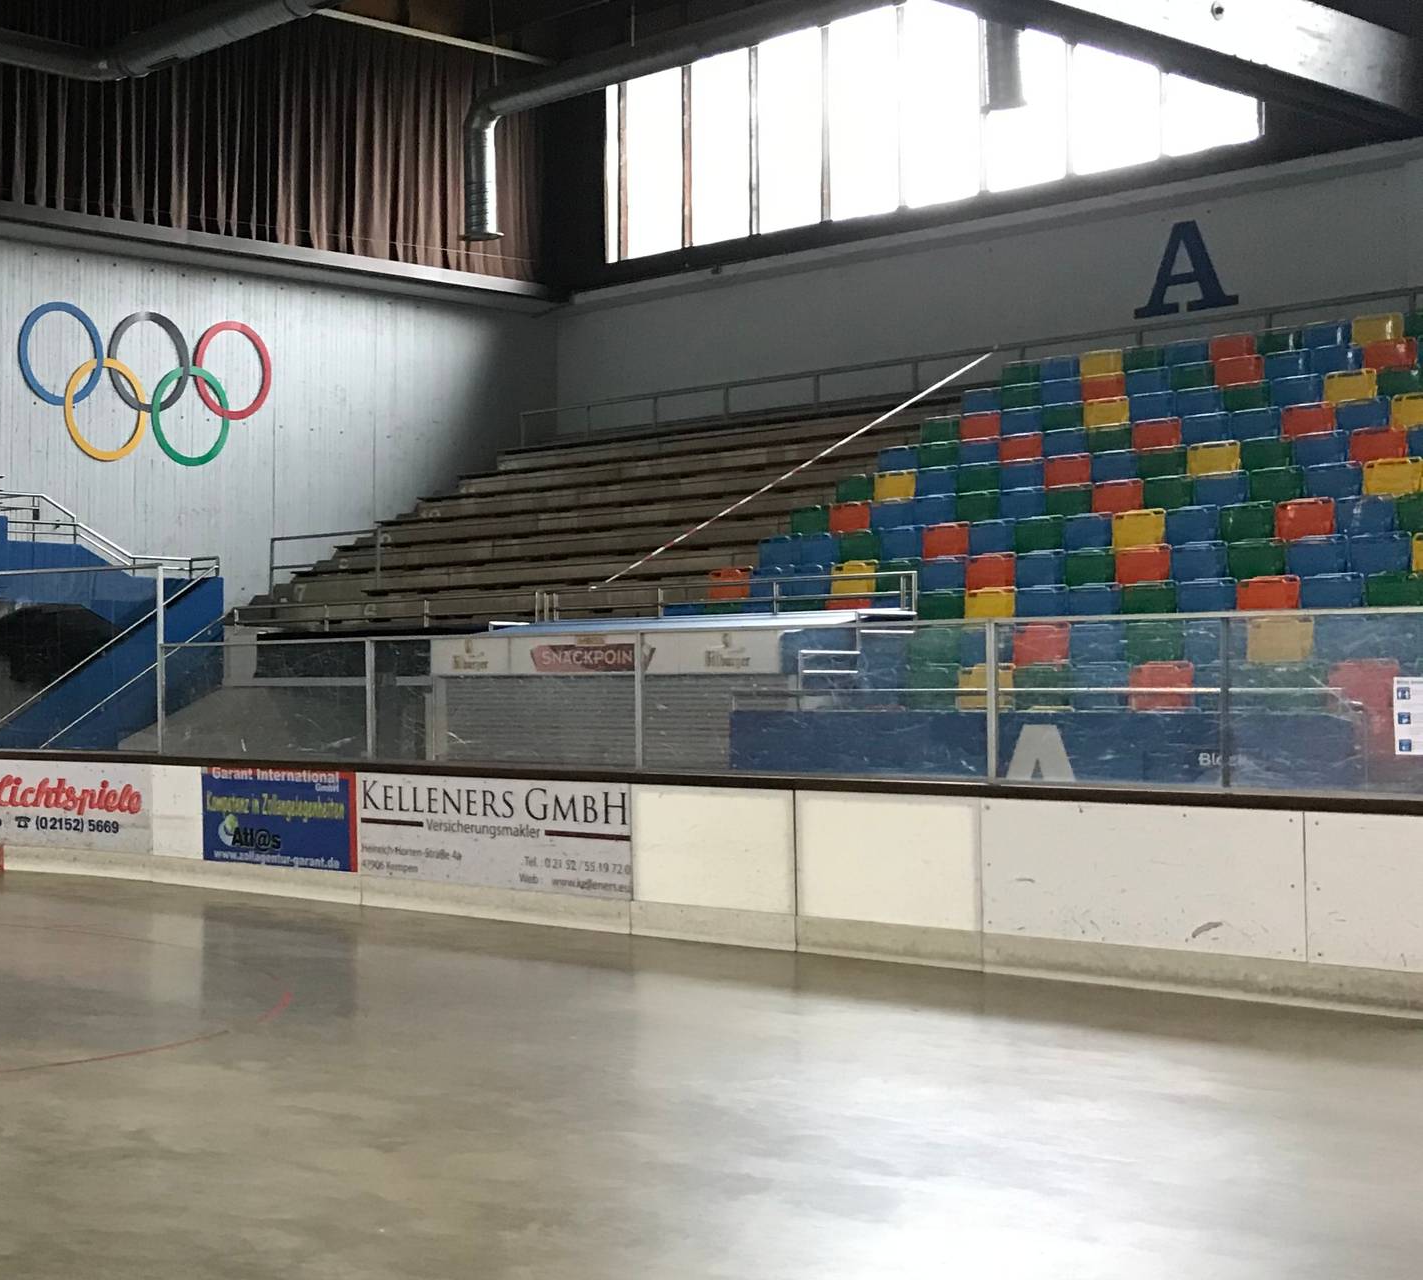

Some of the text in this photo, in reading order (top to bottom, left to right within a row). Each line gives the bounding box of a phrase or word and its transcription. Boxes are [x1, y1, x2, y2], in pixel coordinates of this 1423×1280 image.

[1134, 219, 1239, 319] A
[541, 649, 634, 666] SNACKPOIN
[1005, 723, 1076, 780] A
[212, 766, 339, 784] Garant International
[315, 783, 340, 793] GmbH
[362, 780, 515, 819] KELLENERS
[88, 819, 119, 834] 5669
[426, 818, 540, 839] Versicherungsmakler
[231, 826, 281, 851] Atl@s
